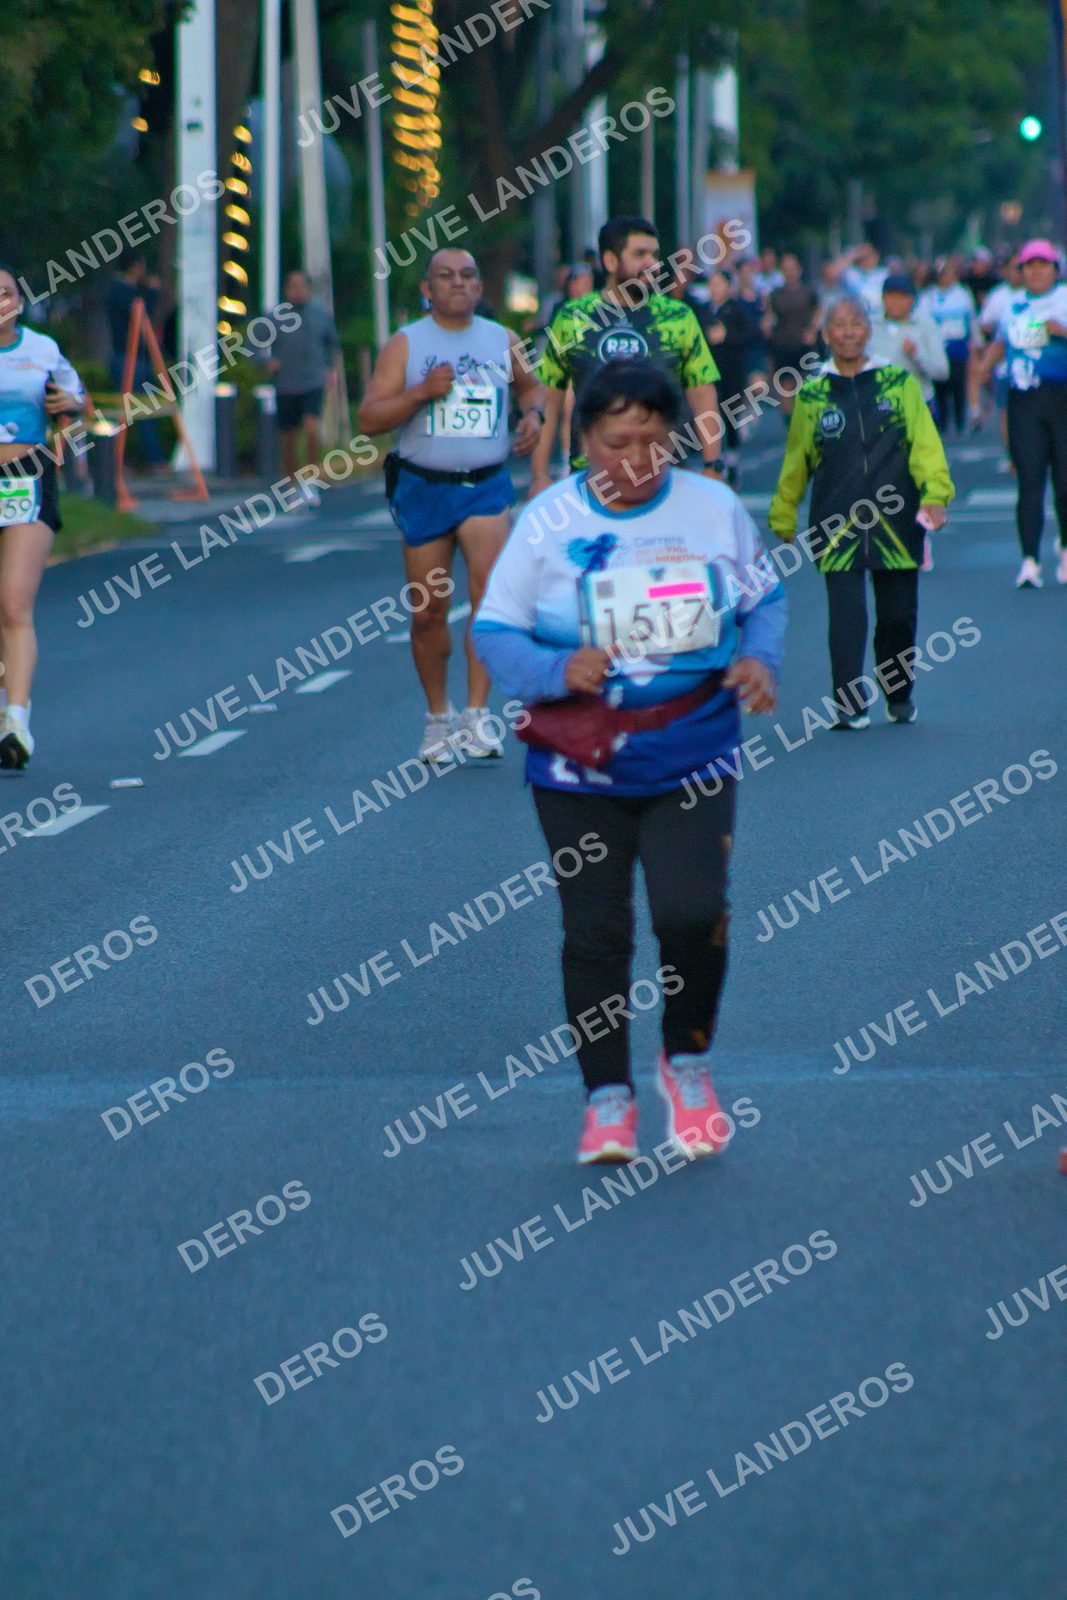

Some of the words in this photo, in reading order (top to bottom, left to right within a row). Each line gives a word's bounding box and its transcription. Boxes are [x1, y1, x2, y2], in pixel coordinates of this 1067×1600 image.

[607, 338, 640, 354] R23
[440, 407, 491, 430] 1591
[603, 597, 709, 645] 1517
